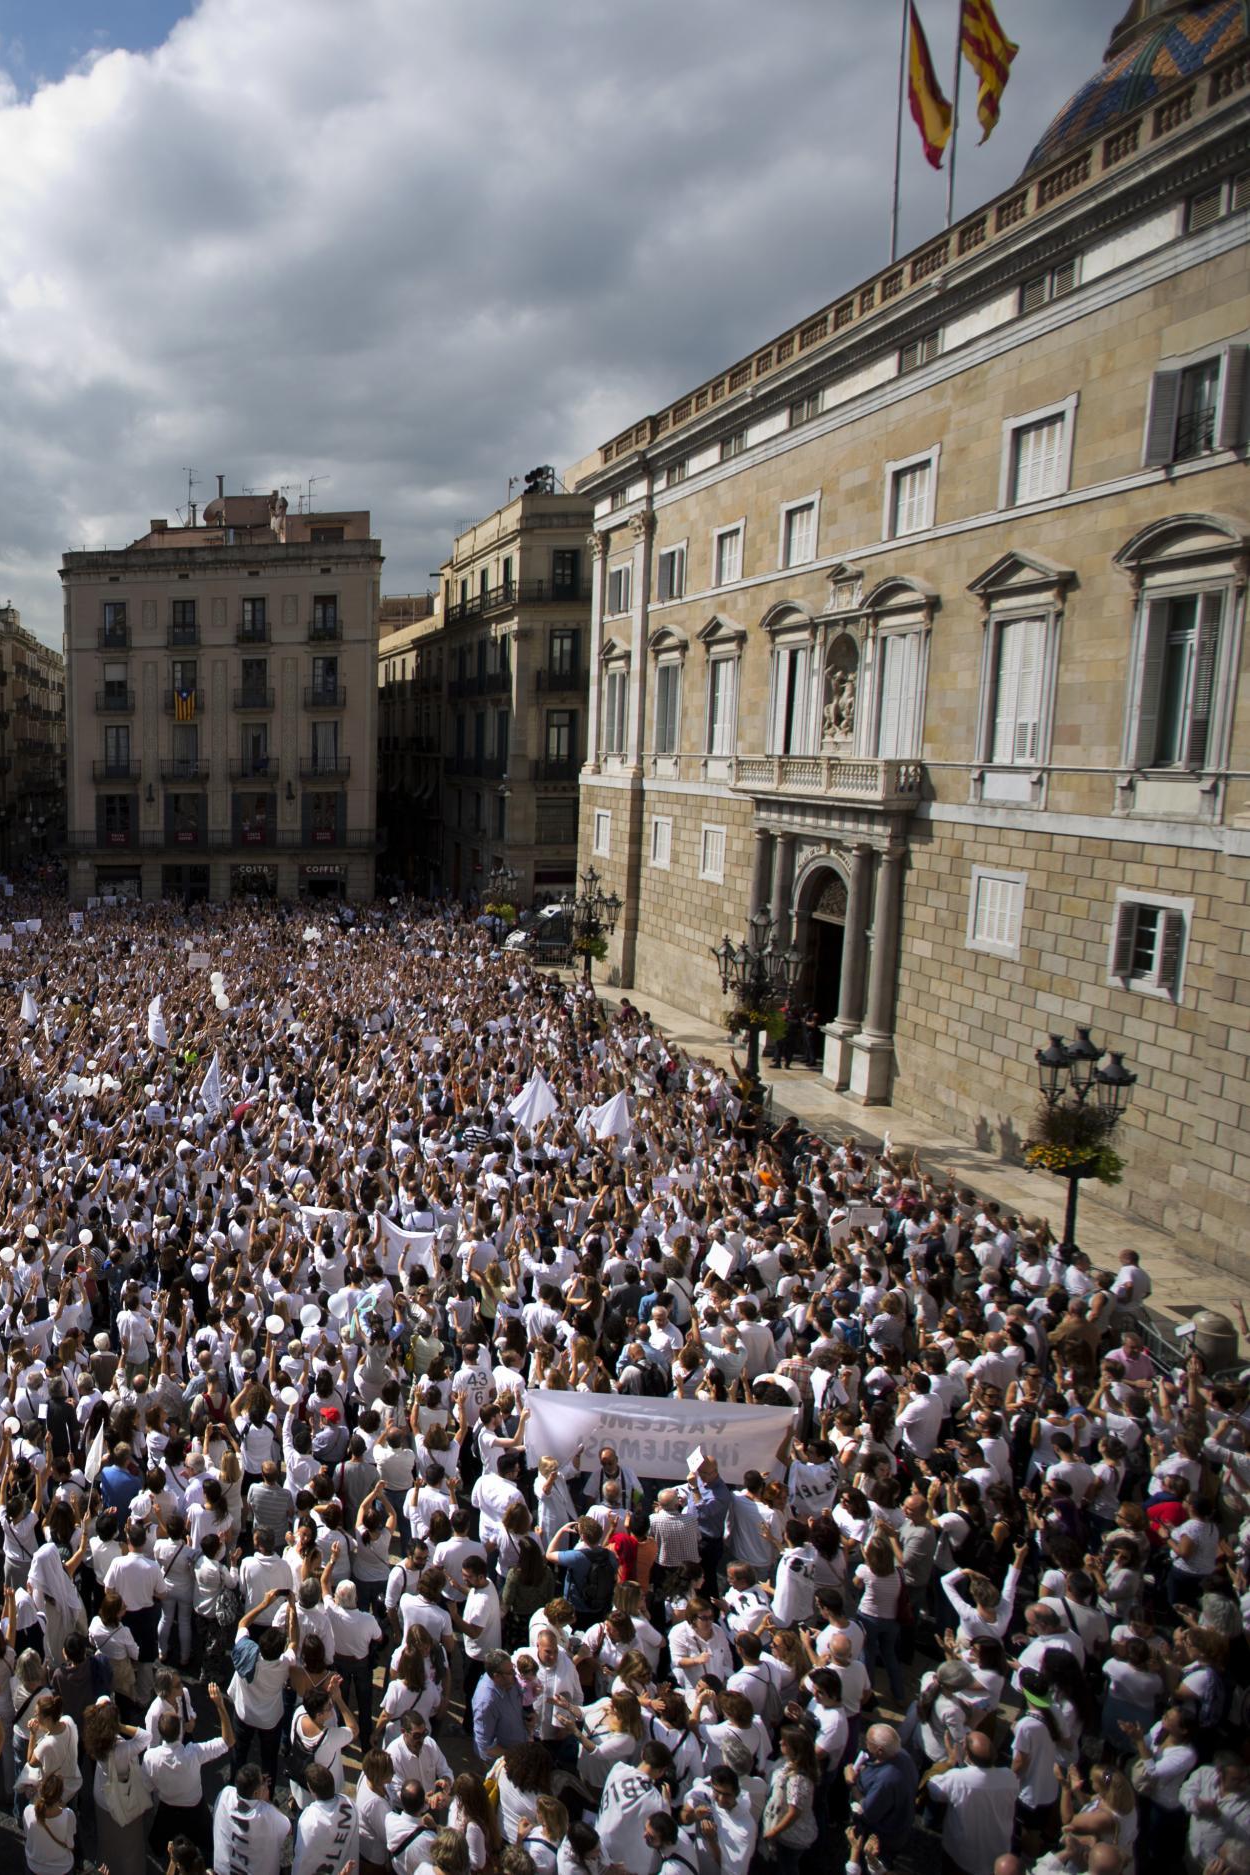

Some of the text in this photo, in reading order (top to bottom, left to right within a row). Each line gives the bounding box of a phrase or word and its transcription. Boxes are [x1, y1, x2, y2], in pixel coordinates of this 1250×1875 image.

[239, 865, 341, 873] COSTA COFFEE
[467, 1371, 488, 1386] 43
[474, 1390, 483, 1405] 6
